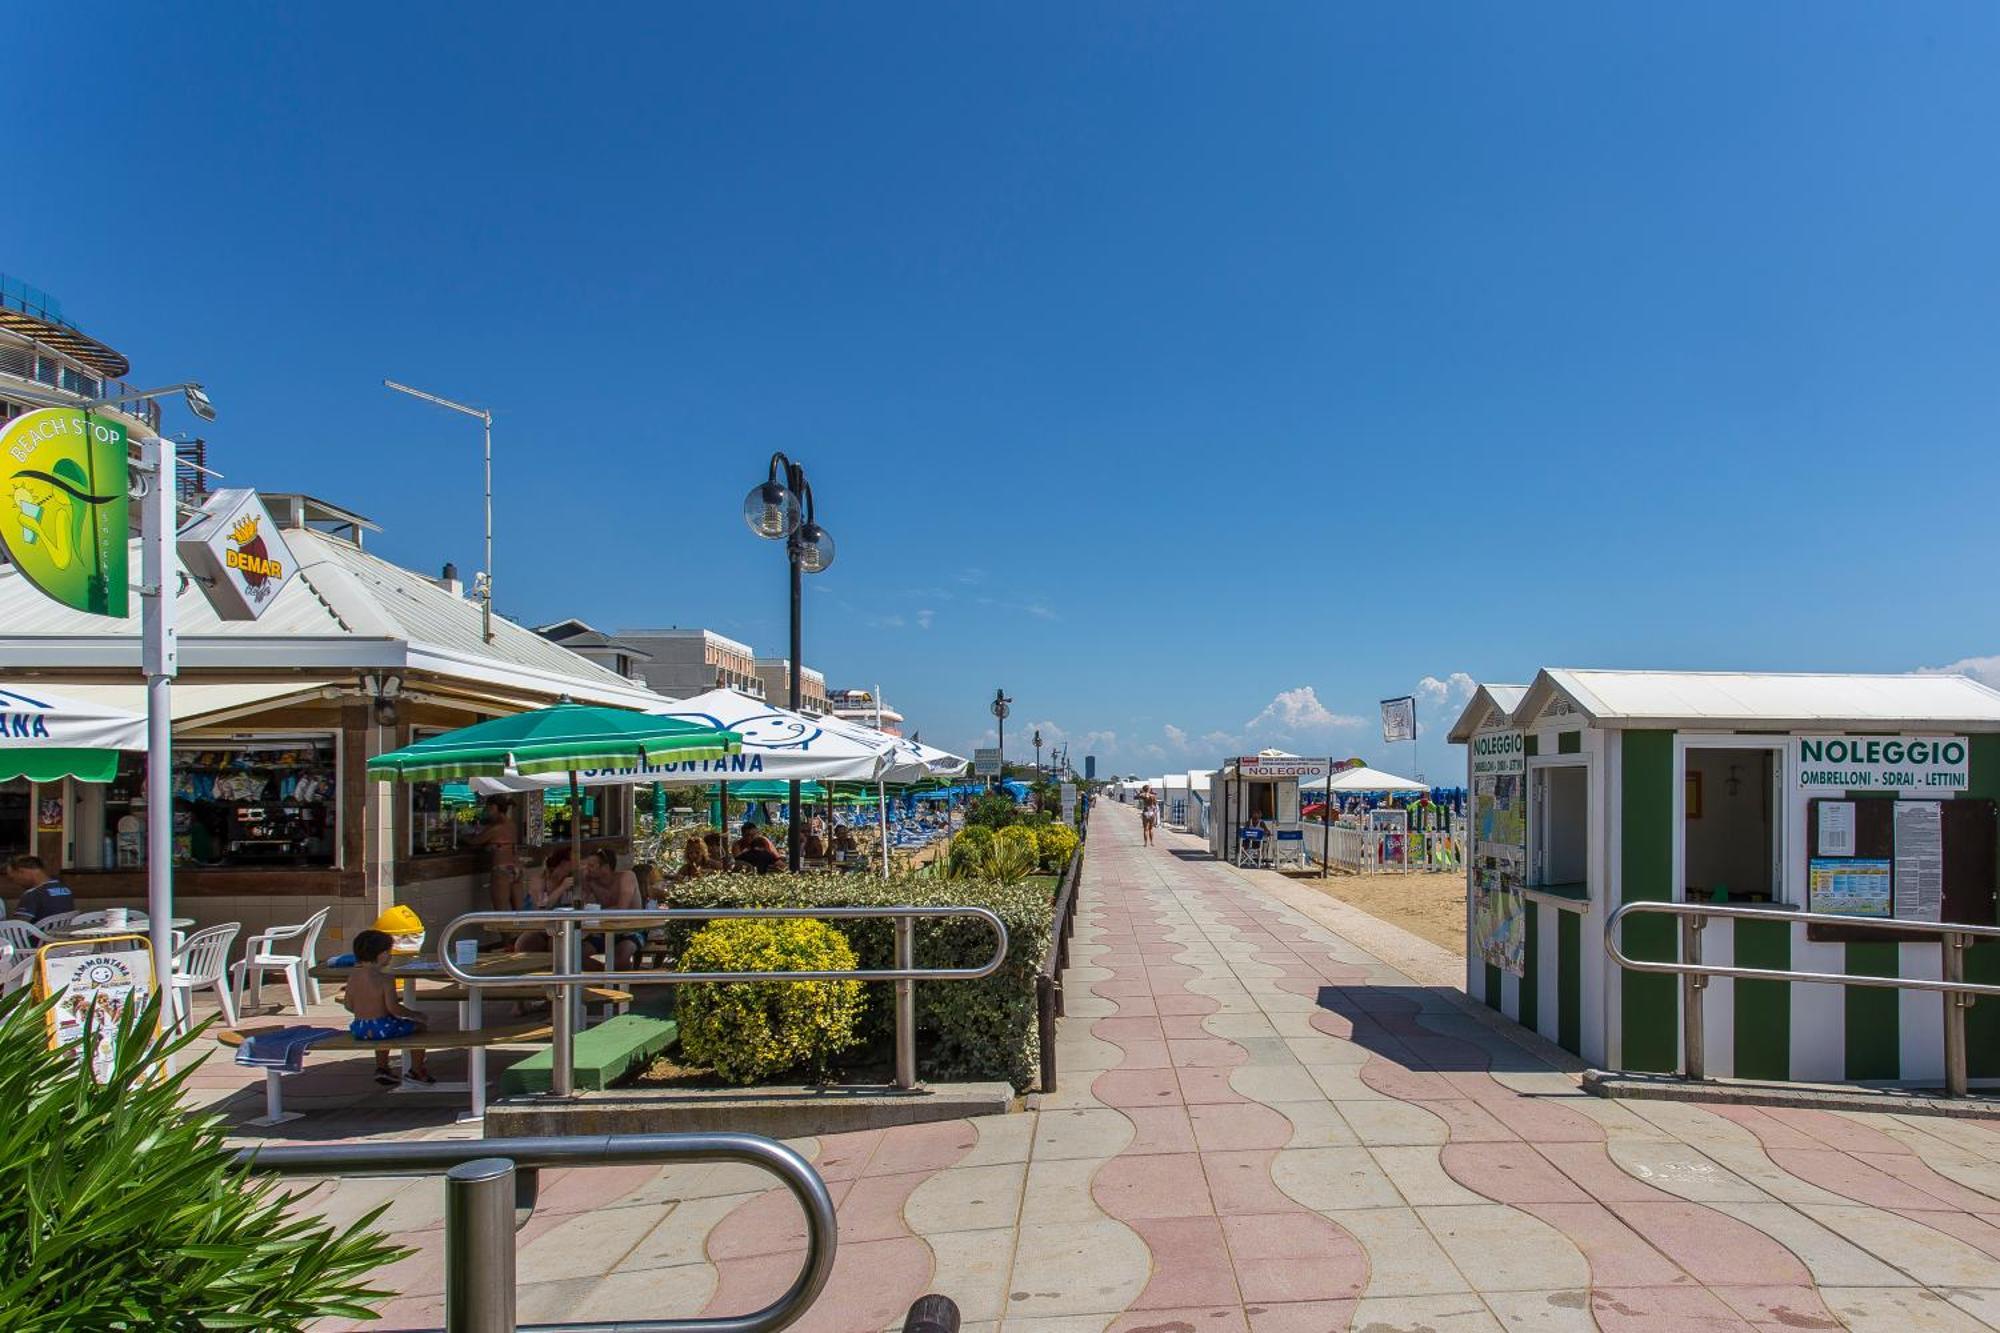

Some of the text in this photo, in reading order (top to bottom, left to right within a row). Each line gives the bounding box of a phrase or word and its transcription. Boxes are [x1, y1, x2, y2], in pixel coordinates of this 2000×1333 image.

[9, 416, 120, 463] BEACH STOP
[226, 548, 282, 580] DEMAR
[1474, 734, 1522, 755] NOLEGGIO
[1801, 740, 1965, 765] NOLEGGIO
[1248, 767, 1321, 775] NOLEGGIO
[1801, 771, 1871, 785] OMBRELLONI
[1882, 772, 1914, 785] SDRAI
[1925, 773, 1965, 786] LETTINI
[71, 957, 130, 982] SAMMONTANA
